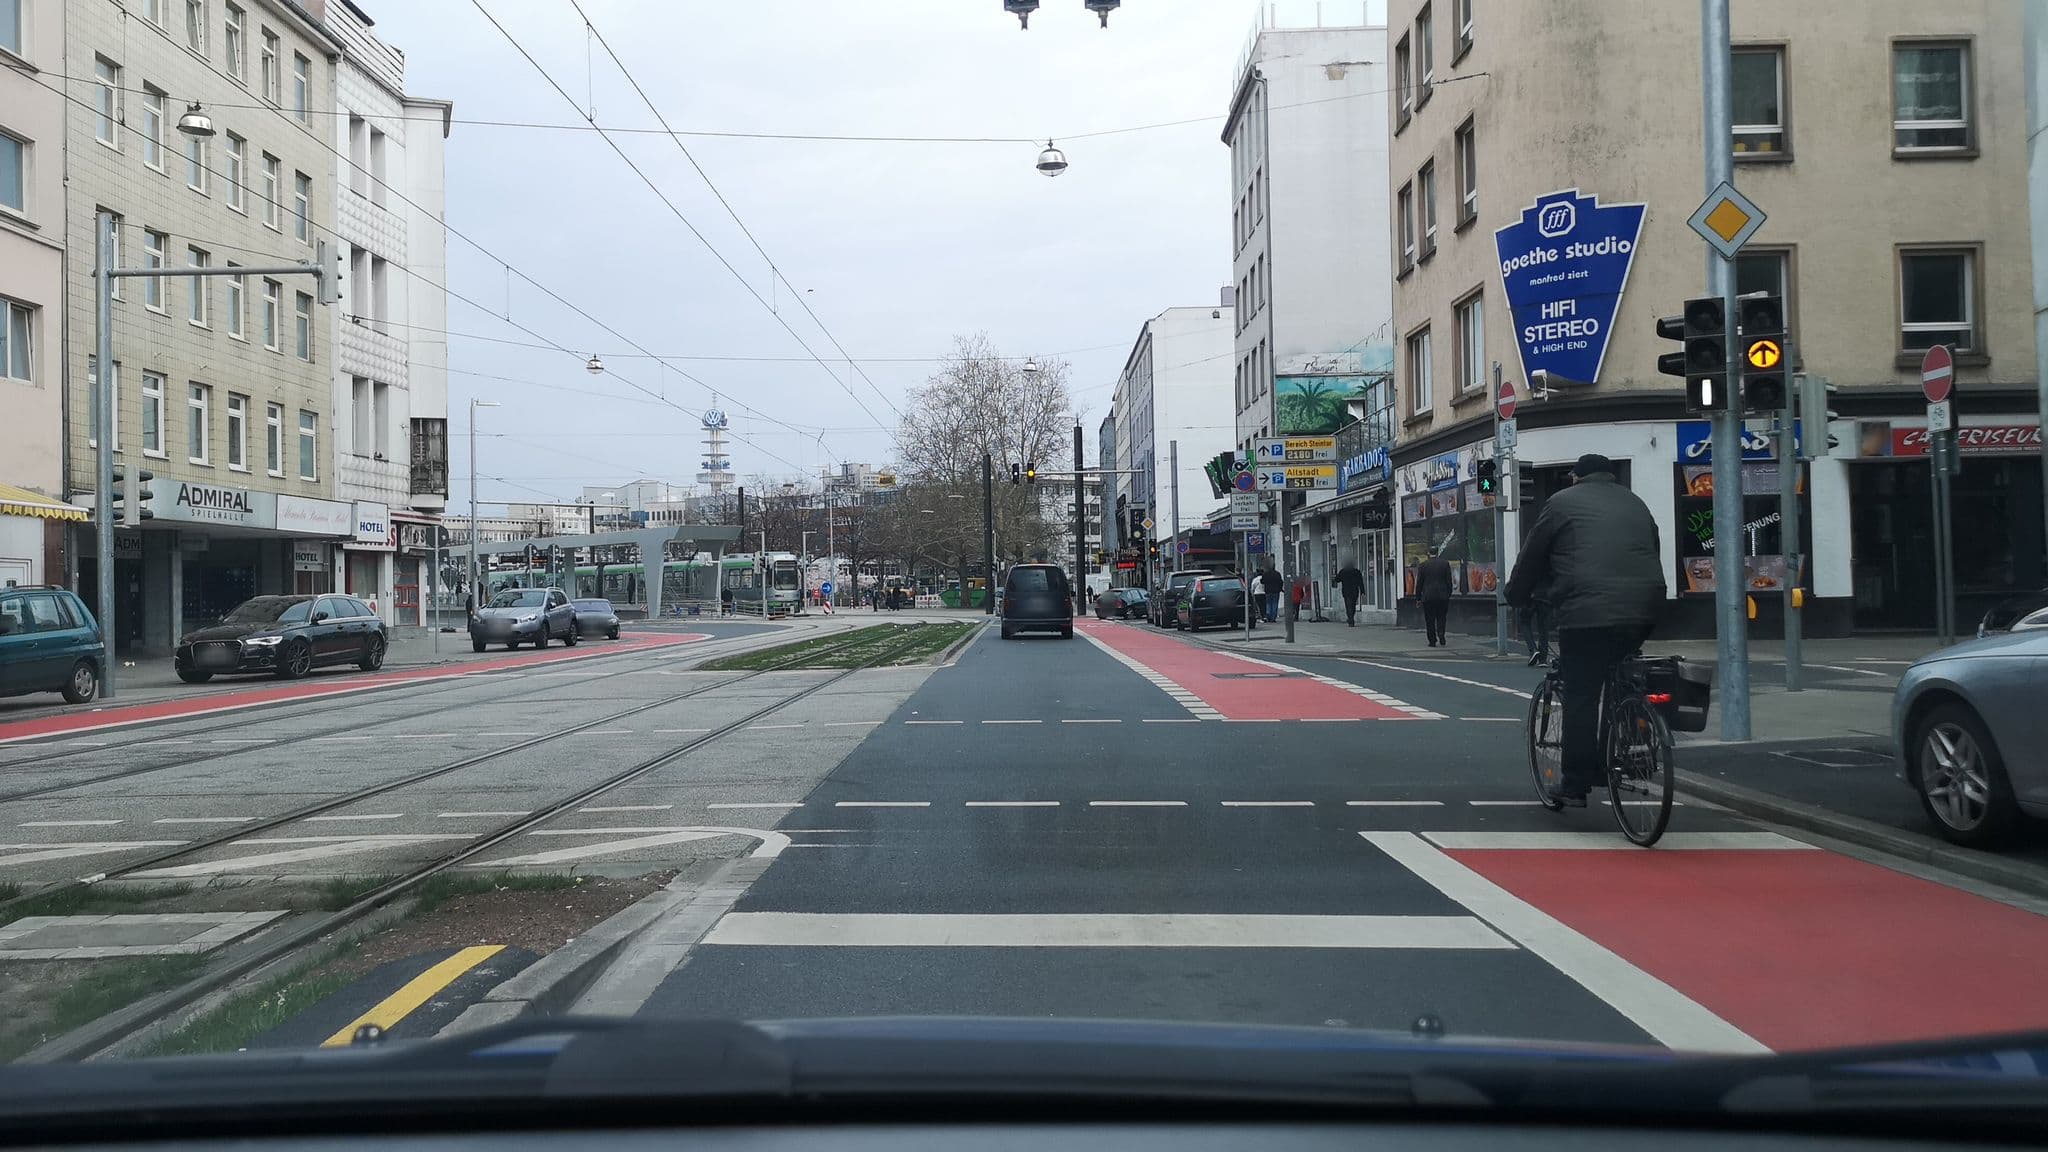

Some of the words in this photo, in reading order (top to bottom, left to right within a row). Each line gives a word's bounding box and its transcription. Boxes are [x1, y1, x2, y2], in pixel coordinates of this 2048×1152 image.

[1544, 208, 1569, 230] fff
[1502, 247, 1559, 277] goethe
[1565, 236, 1632, 259] studio
[1529, 271, 1565, 287] manfred
[1567, 270, 1590, 281] ziert
[1541, 299, 1576, 320] HIFI
[1524, 318, 1599, 344] STEREO
[1533, 344, 1539, 355] &
[1542, 342, 1564, 354] HIGH
[1567, 340, 1588, 350] END
[1285, 440, 1308, 449] Bereich
[1315, 450, 1328, 458] frei
[1345, 446, 1383, 477] BARBADOS
[1287, 467, 1319, 477] Altstadt
[1316, 478, 1329, 486] frei
[176, 482, 253, 514] ADMIRAL
[191, 508, 245, 522] SPIELHALLE
[1365, 510, 1387, 524] sky
[360, 521, 385, 533] HOTEL
[295, 551, 318, 562] HOTEL
